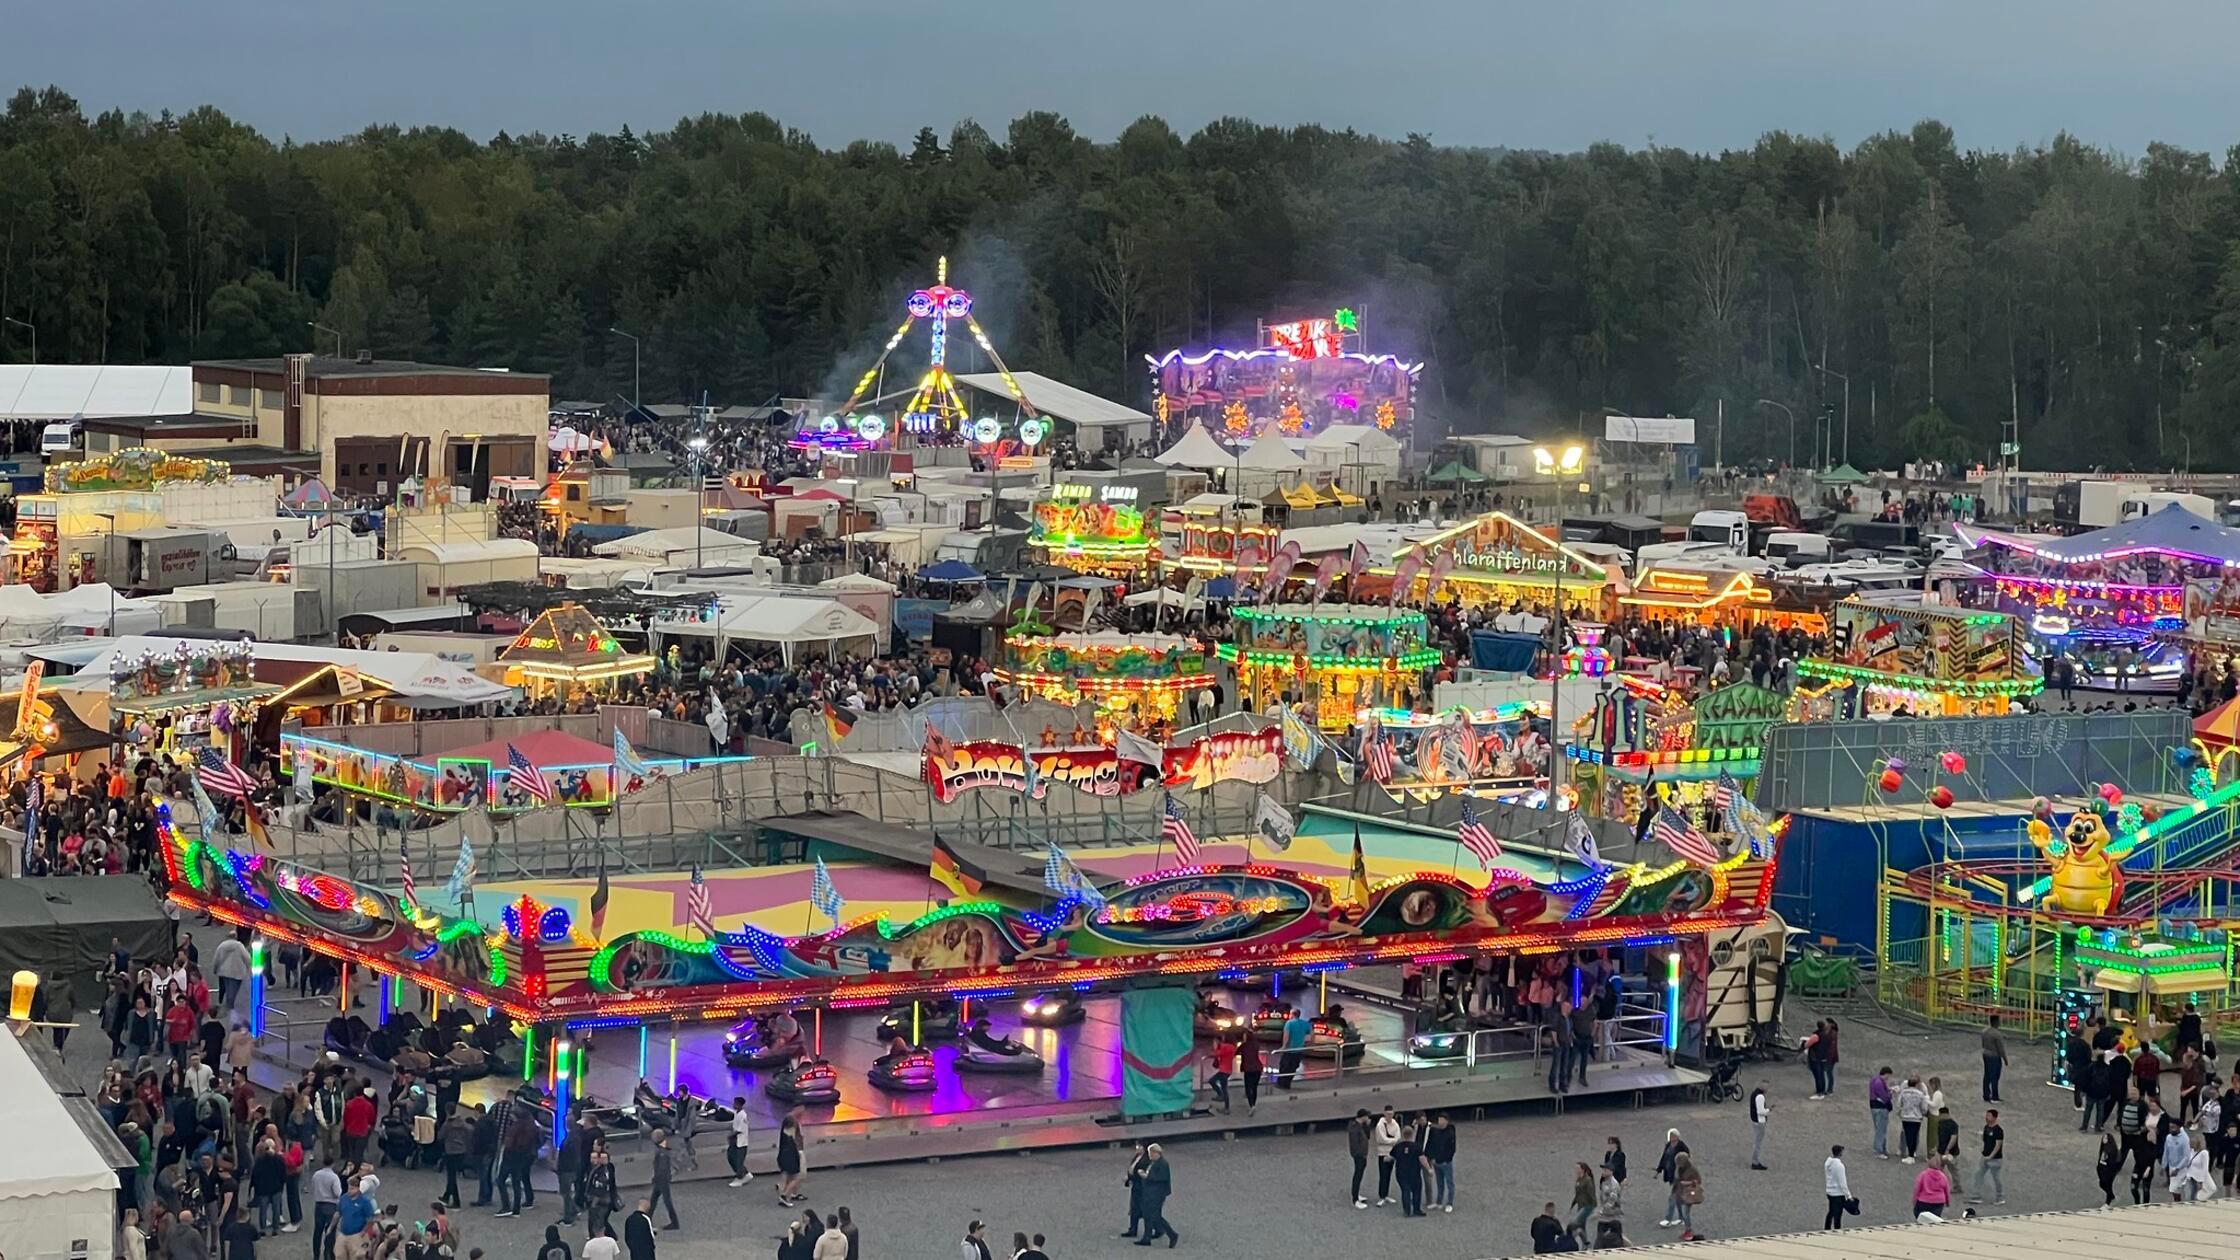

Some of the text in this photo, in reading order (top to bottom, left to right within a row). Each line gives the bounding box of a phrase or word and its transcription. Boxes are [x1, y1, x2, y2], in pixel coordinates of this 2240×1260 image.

[1271, 319, 1331, 347] BREAK
[1101, 485, 1139, 502] SAMBA
[1425, 544, 1567, 573] Shlaraffenland
[1701, 722, 1767, 748] PALAC
[934, 751, 1119, 802] Bowling
